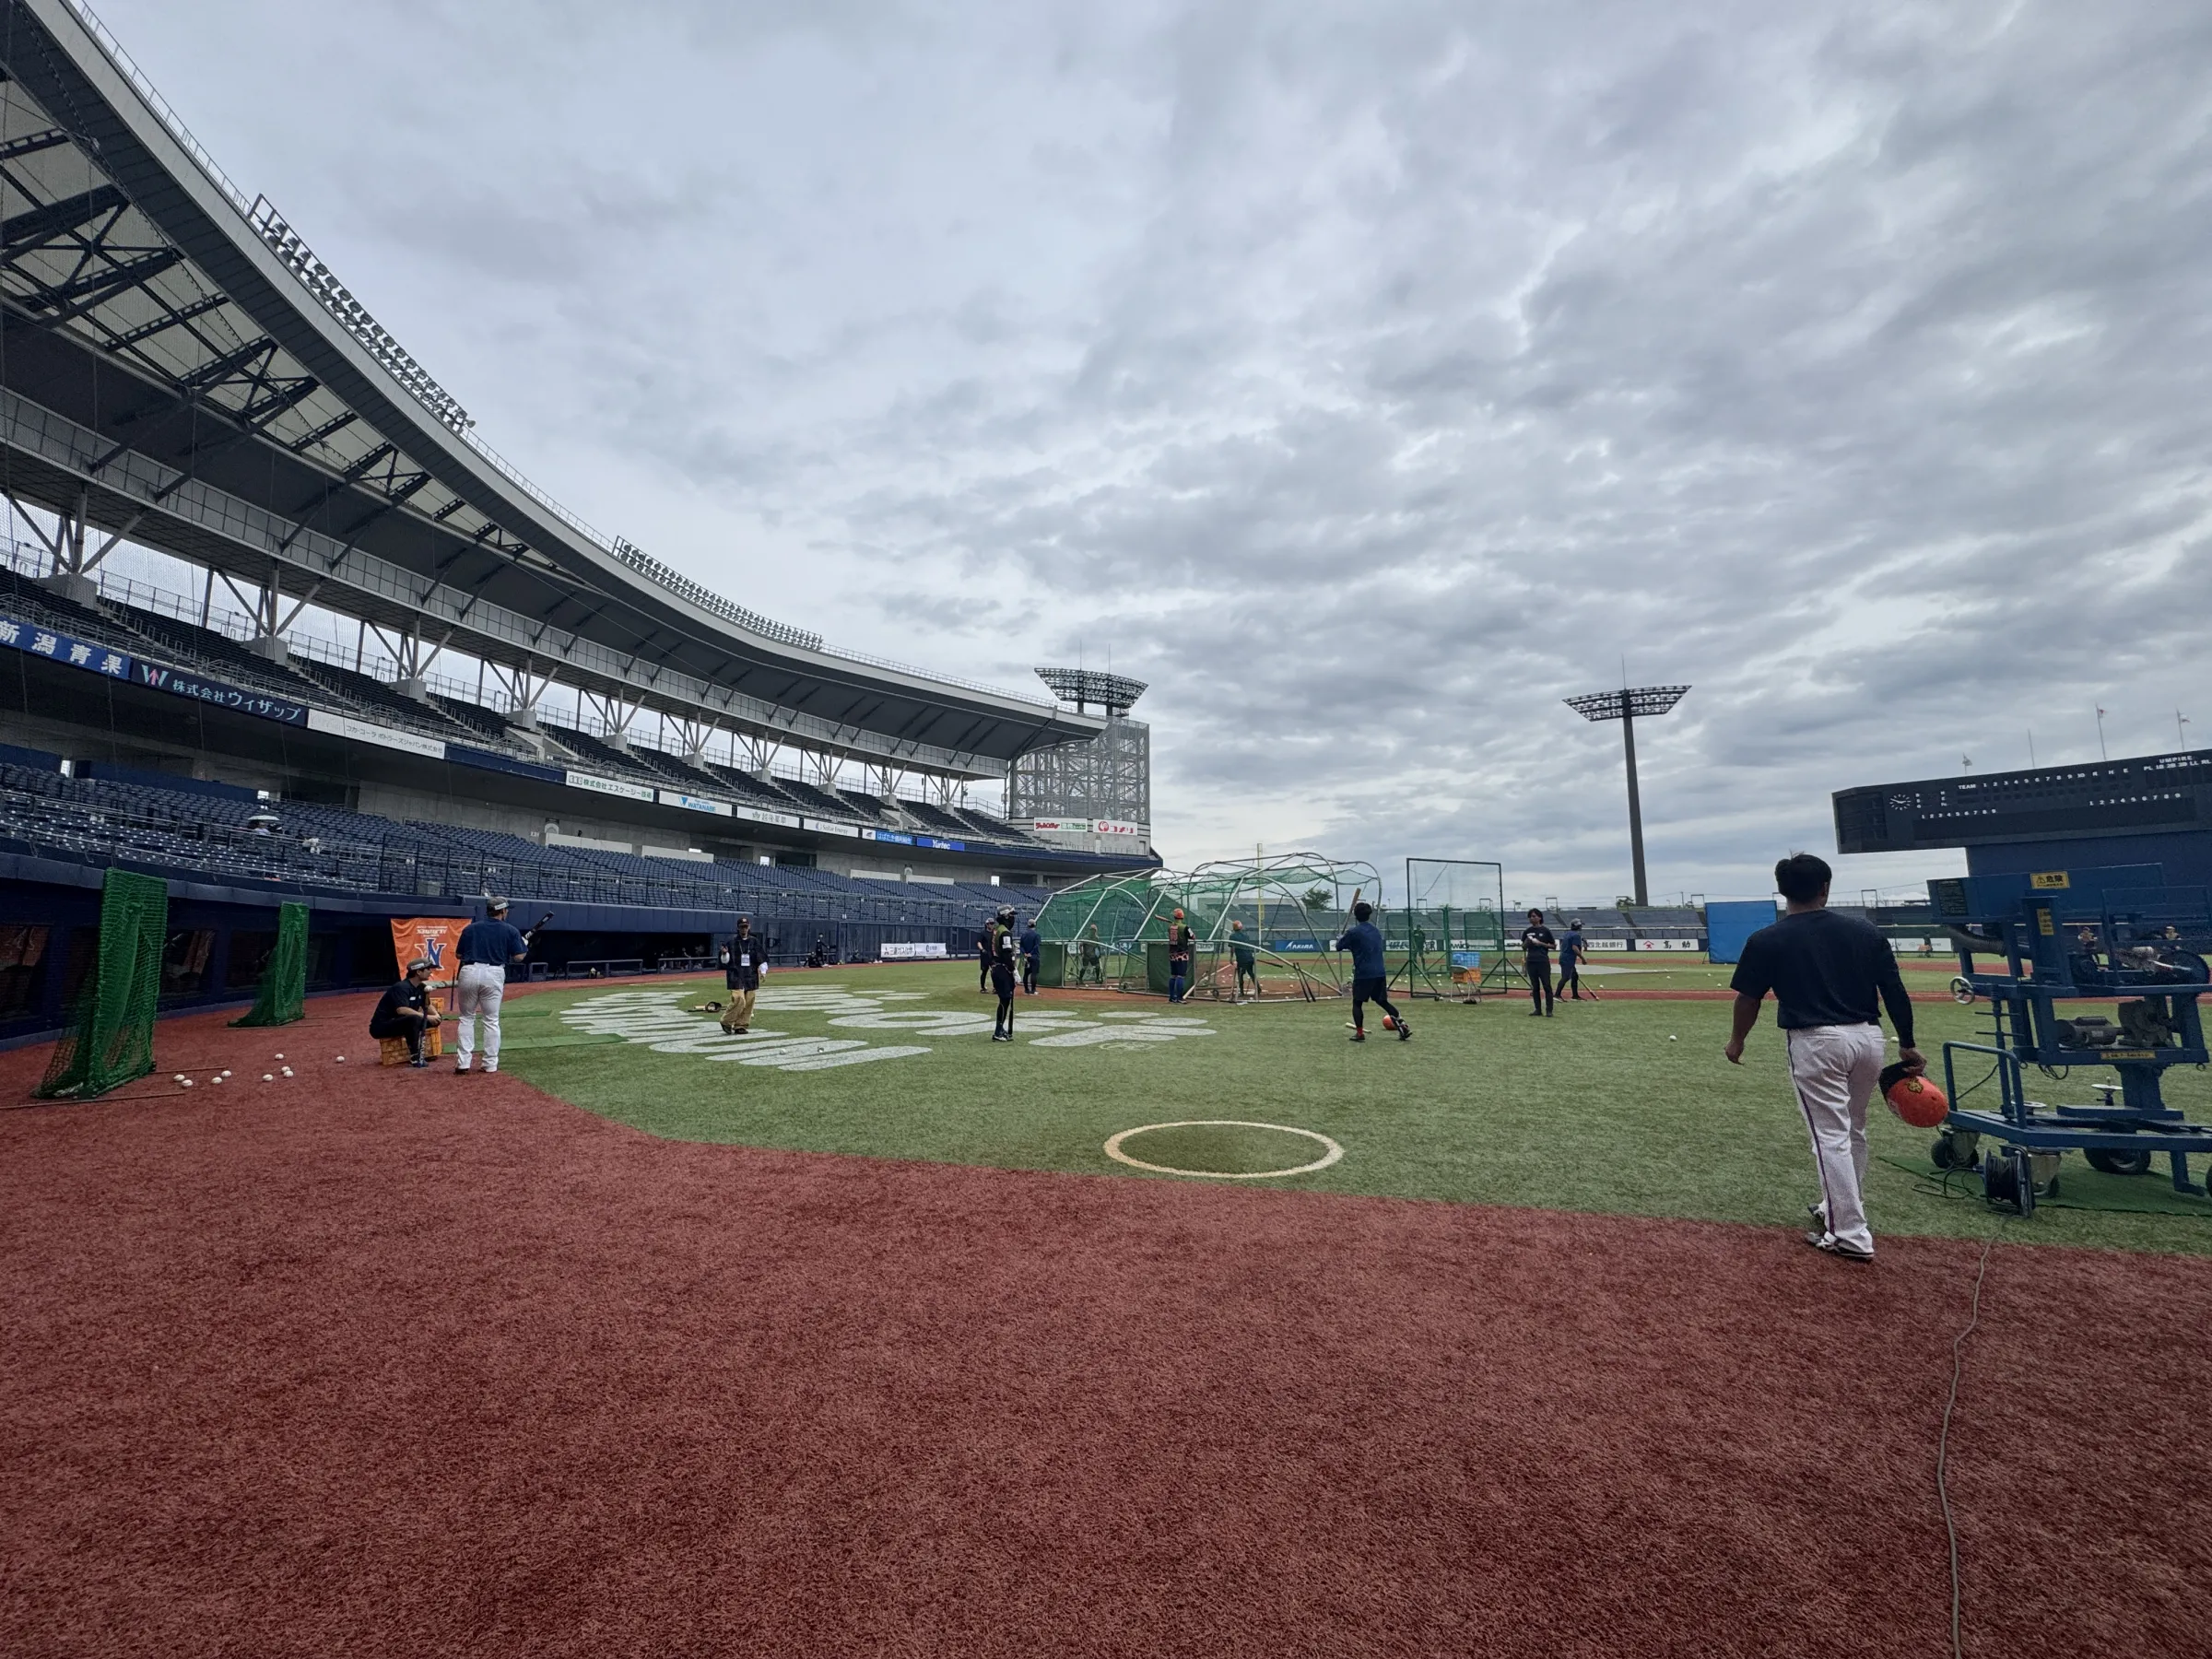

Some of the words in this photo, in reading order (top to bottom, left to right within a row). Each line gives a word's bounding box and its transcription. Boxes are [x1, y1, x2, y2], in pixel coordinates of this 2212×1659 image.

[0, 620, 122, 675] 新潟青果
[172, 678, 301, 721] 株式会社ウィザップ
[2159, 755, 2193, 764] UMPIRE
[688, 802, 716, 813] WATANABE
[932, 839, 951, 850] Yurtec
[1285, 940, 1313, 949] AKIRA
